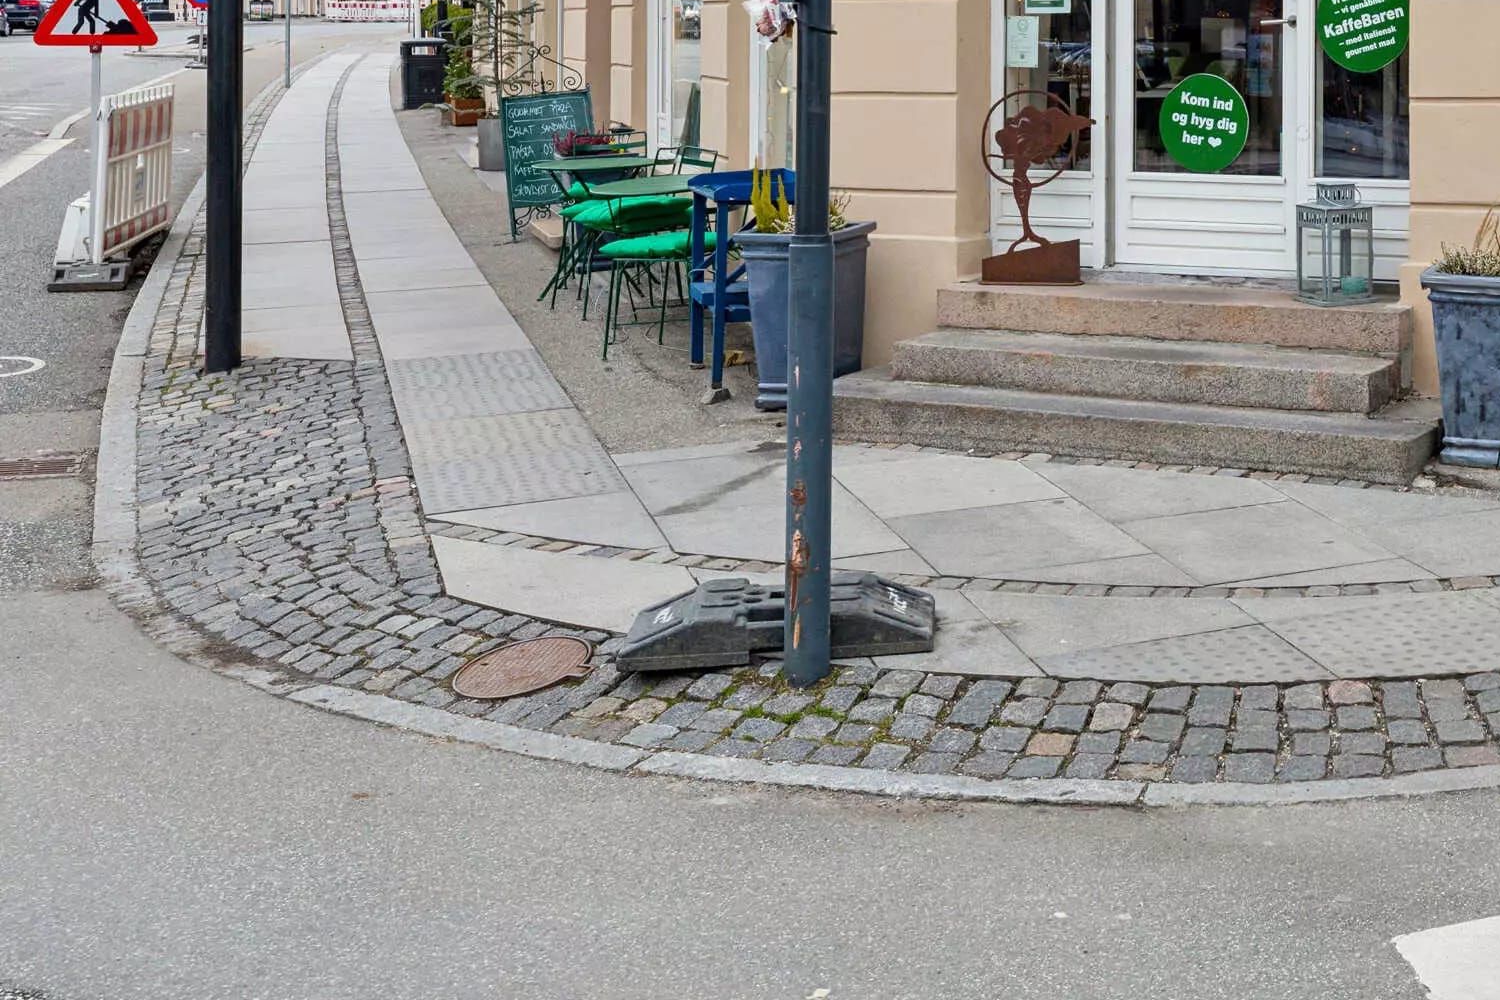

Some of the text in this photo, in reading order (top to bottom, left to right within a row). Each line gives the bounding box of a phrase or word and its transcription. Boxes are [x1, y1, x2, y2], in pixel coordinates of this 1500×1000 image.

[1341, 5, 1349, 14] vi
[1323, 7, 1405, 39] KaffeBaren
[1345, 34, 1362, 46] med
[1345, 37, 1396, 59] gourmet mad
[1181, 91, 1233, 111] Kom ind
[1172, 112, 1238, 134] og hyg dig
[1182, 130, 1204, 145] her
